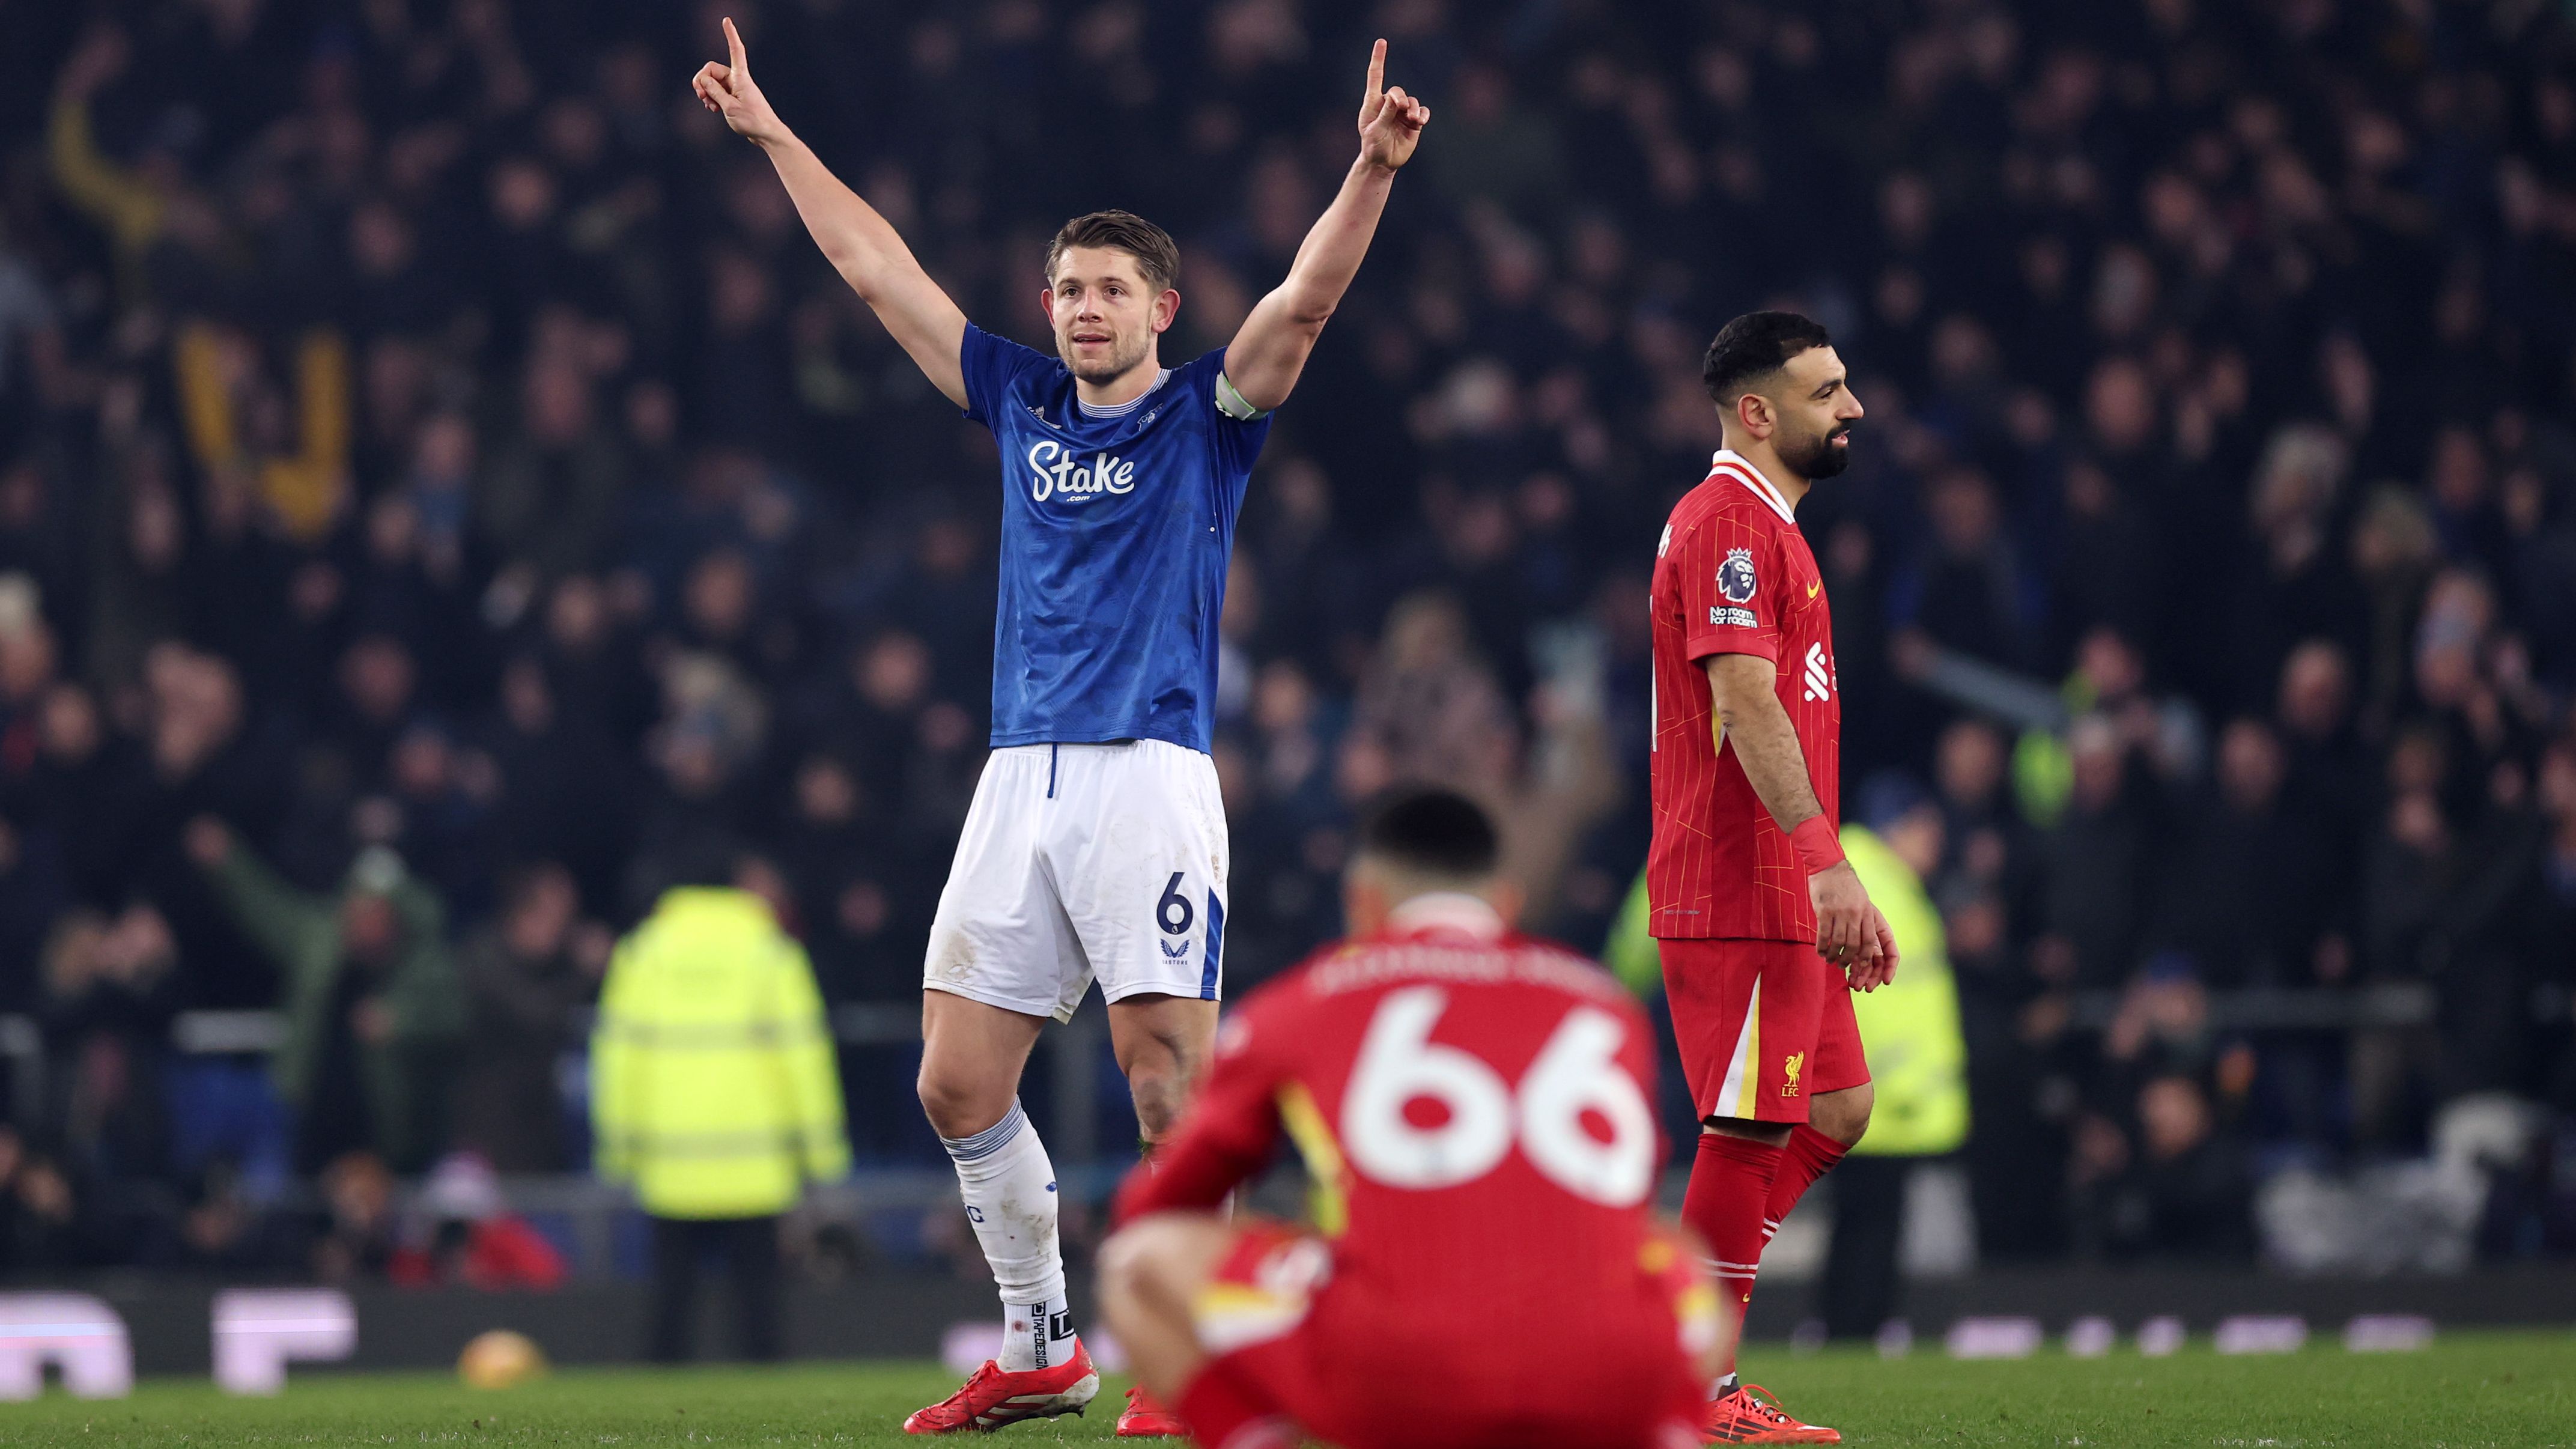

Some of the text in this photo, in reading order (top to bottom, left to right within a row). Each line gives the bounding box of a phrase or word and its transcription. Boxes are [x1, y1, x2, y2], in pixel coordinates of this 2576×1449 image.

[1028, 440, 1135, 502] Stake
[1710, 606, 1753, 619] No room
[1710, 616, 1726, 624] for
[1156, 872, 1194, 935] 6
[1338, 985, 1657, 1208] 66
